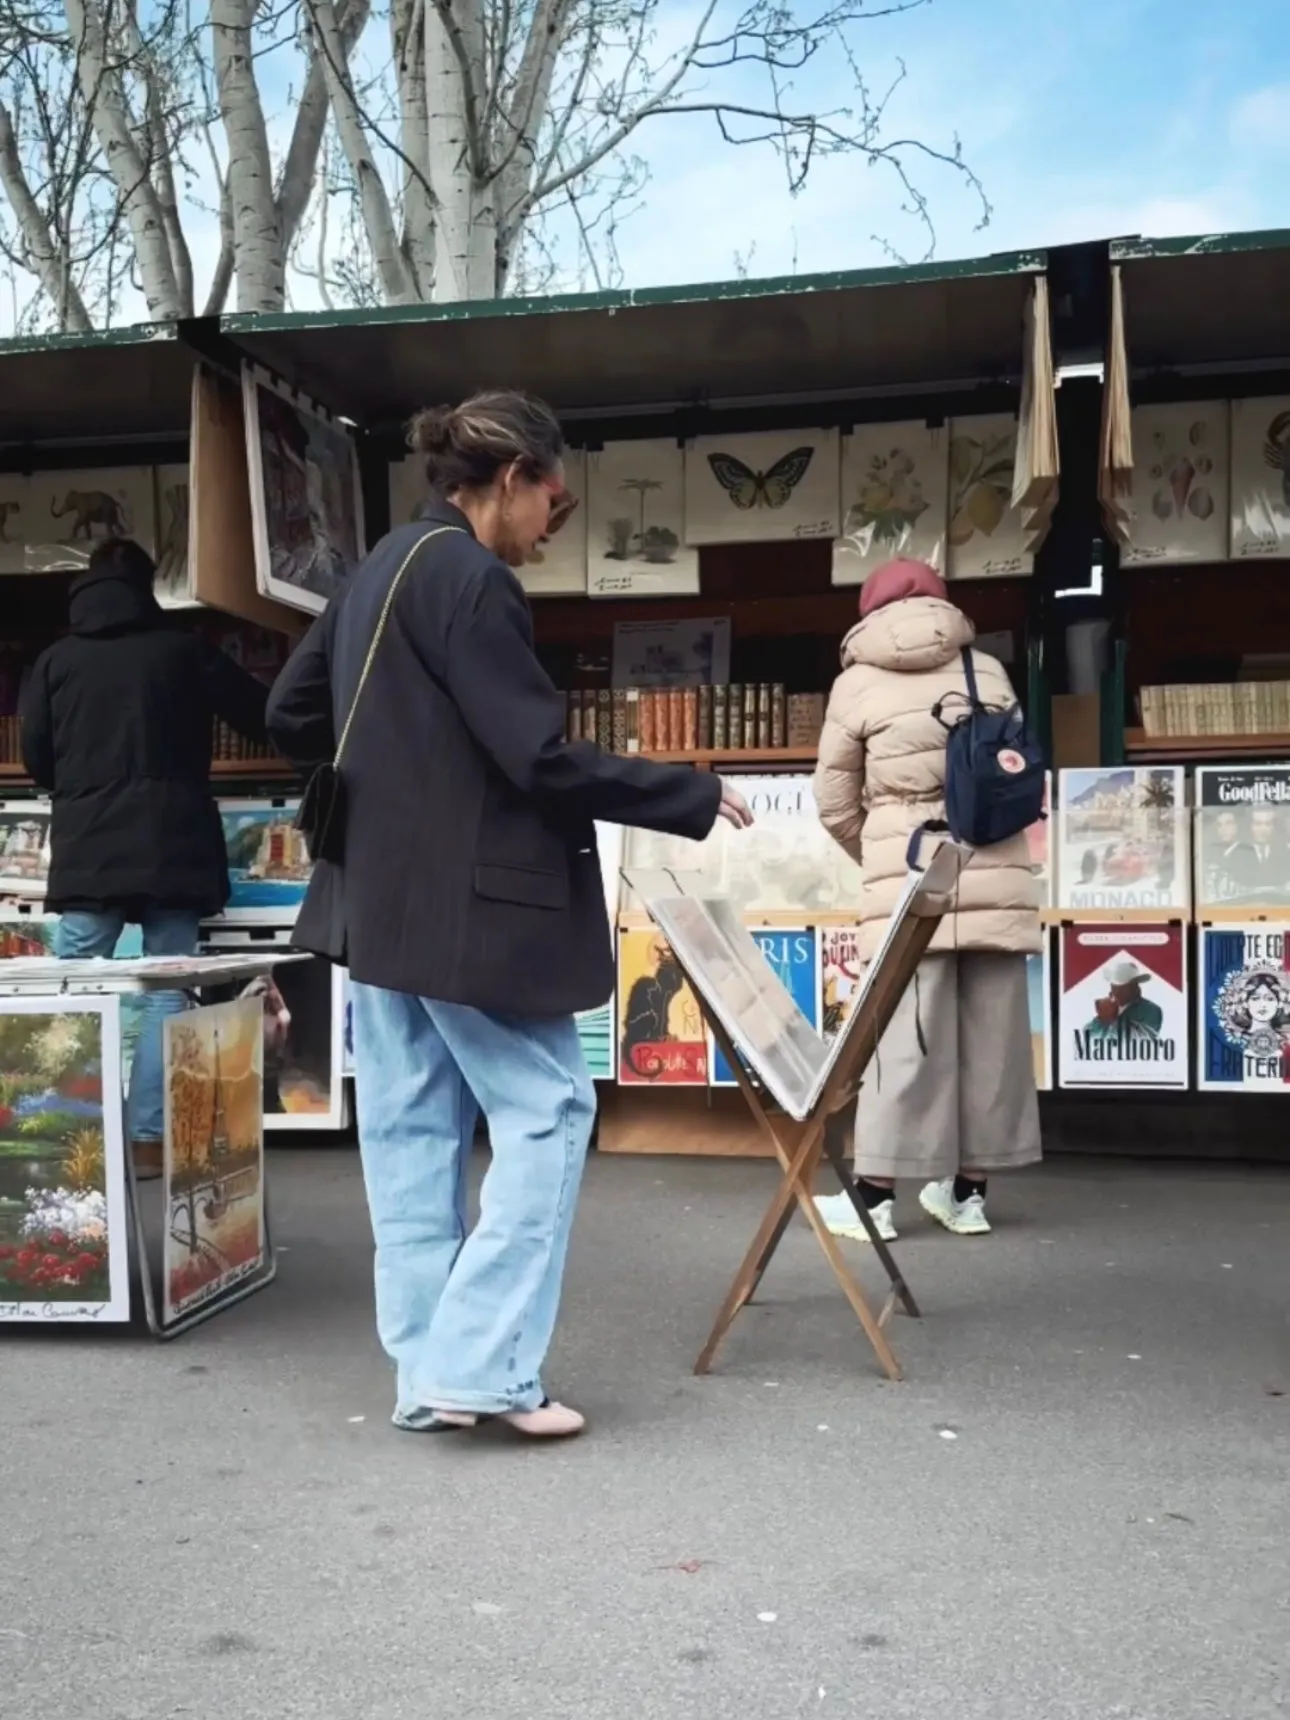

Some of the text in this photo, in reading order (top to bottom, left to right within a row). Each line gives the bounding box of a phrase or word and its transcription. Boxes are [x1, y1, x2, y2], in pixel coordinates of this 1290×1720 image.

[1069, 889, 1173, 909] MONACO
[759, 937, 809, 964] RIS
[1073, 1028, 1175, 1062] Marlboro
